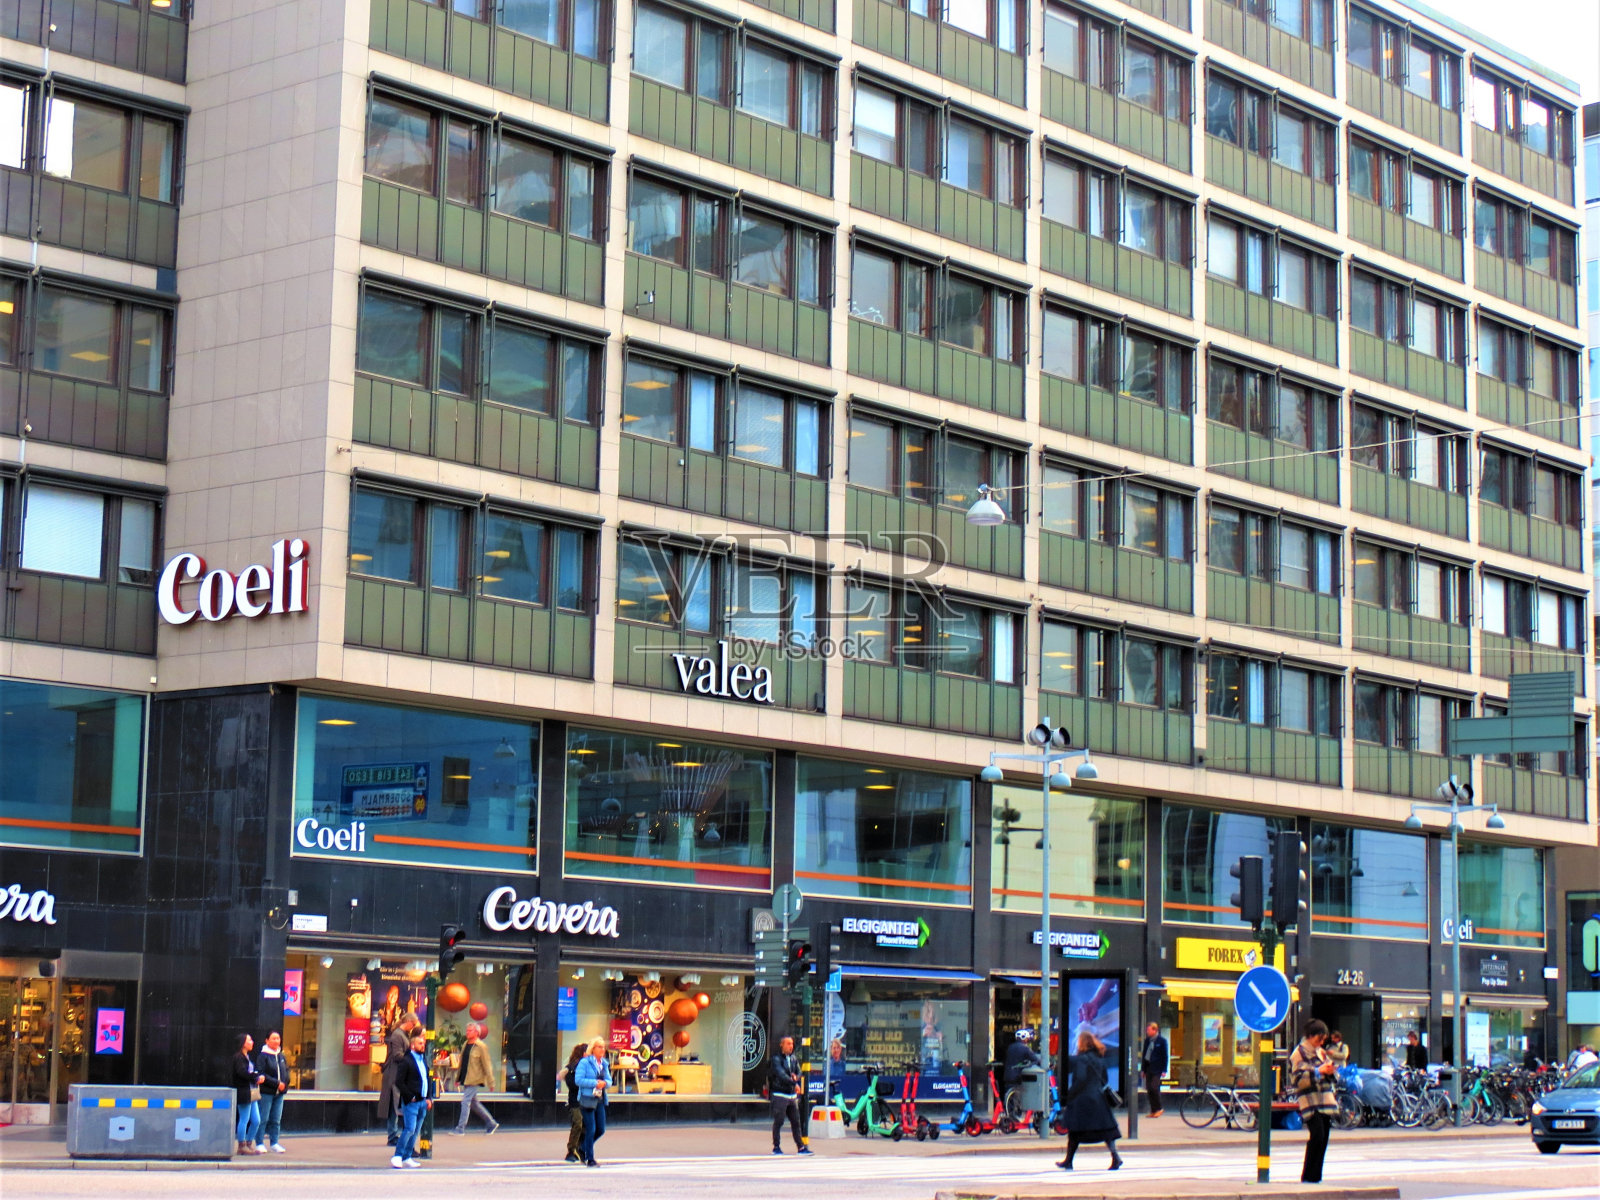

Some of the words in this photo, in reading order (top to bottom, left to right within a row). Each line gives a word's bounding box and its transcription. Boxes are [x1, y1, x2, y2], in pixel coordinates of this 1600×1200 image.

[157, 538, 309, 625] Coeli
[671, 640, 775, 703] valea
[297, 817, 366, 852] Coeli
[483, 886, 620, 938] Cervera
[845, 918, 919, 936] ELGIGANTEN
[1442, 918, 1474, 940] Celi
[1034, 930, 1100, 947] EGIGANTEN
[1208, 947, 1244, 963] FOREX
[1337, 969, 1364, 985] 24-26
[347, 1034, 366, 1045] 25%
